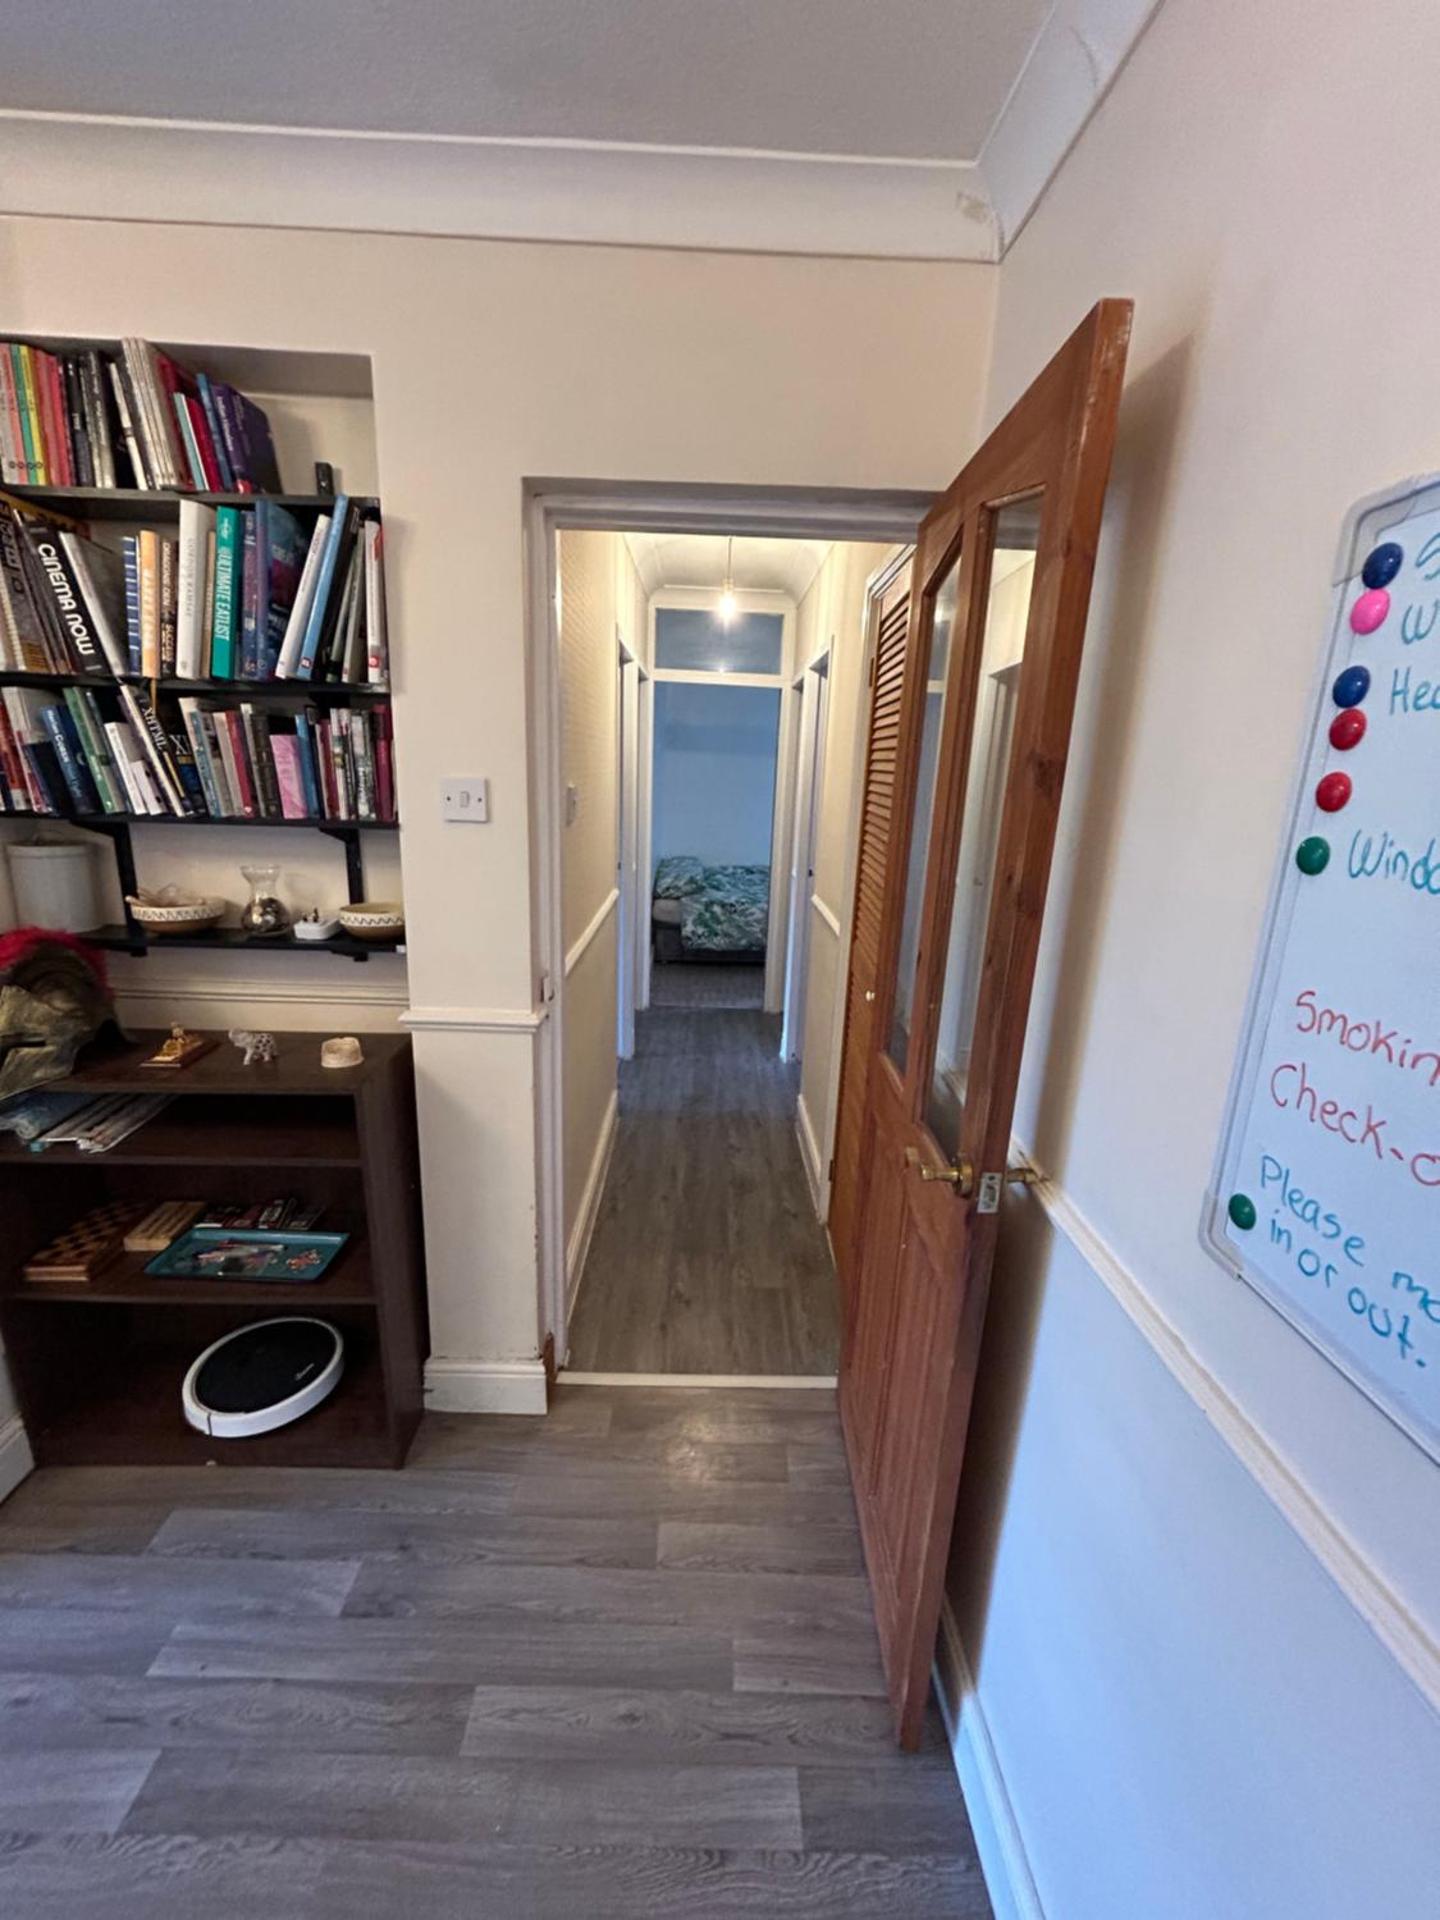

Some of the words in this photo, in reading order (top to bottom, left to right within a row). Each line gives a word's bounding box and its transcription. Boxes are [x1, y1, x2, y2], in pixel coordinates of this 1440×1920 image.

[38, 543, 77, 612] CINEMA
[64, 613, 95, 656] NOW
[214, 602, 231, 641] EATLIST
[215, 555, 232, 602] ULTIMATE
[141, 707, 167, 750] XHTML
[1296, 990, 1440, 1087] Smokin
[1261, 1154, 1366, 1267] Please
[1269, 1208, 1293, 1253] in
[1297, 1248, 1338, 1289] or
[1348, 1286, 1427, 1368] out.
